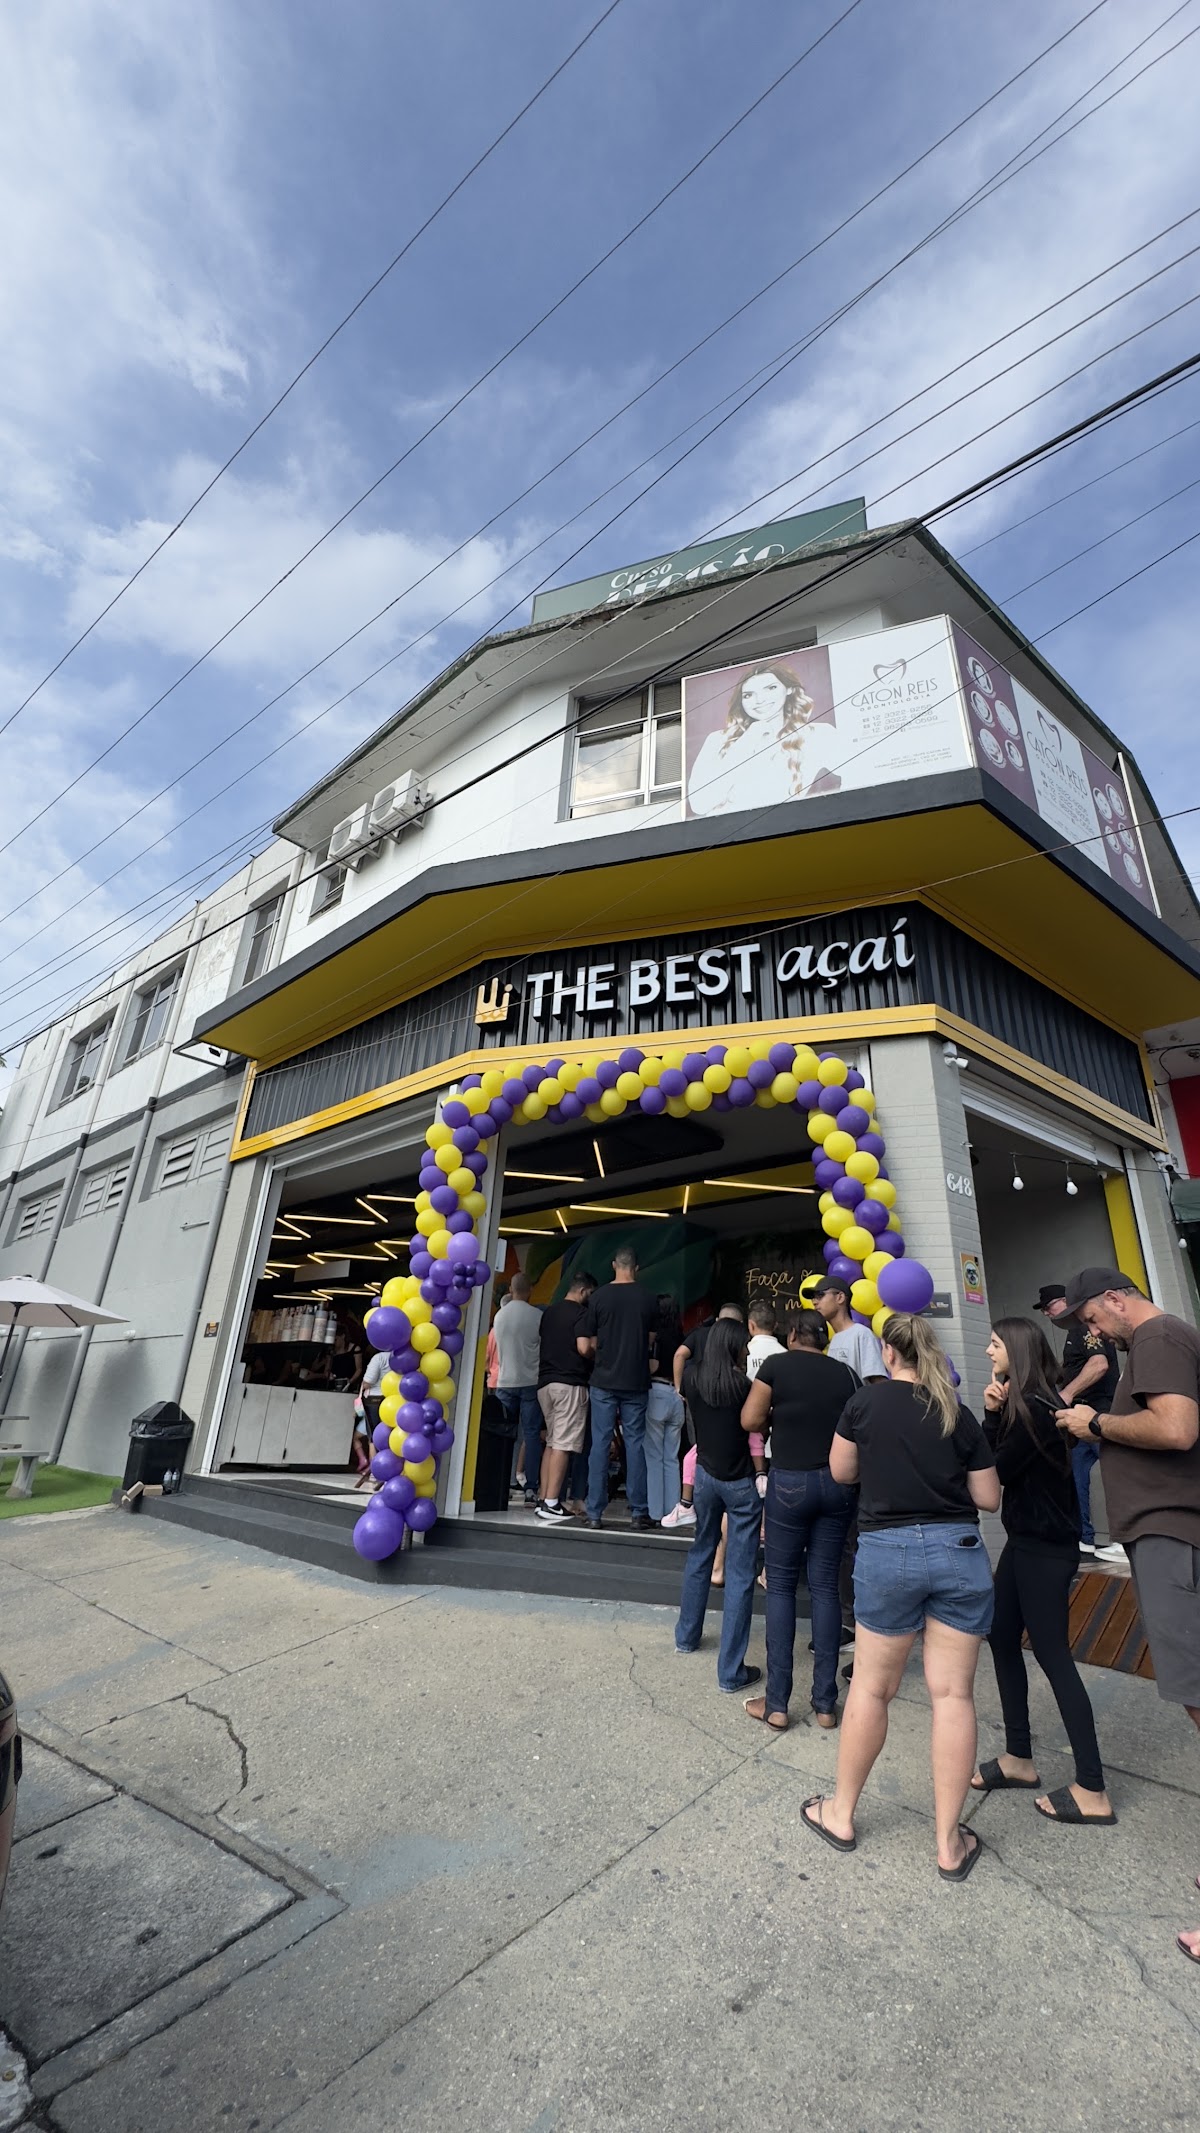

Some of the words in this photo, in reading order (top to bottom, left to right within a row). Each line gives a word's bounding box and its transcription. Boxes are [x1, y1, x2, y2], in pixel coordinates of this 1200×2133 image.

[610, 562, 673, 588] Curso
[851, 685, 902, 707] CATON
[907, 677, 938, 696] REIS
[860, 693, 931, 712] ODONTOLOGIA
[1026, 730, 1065, 776] CATON
[1065, 764, 1088, 797] REIS
[526, 962, 615, 1018] THE
[629, 943, 761, 1007] BEST
[776, 916, 916, 987] açaí
[946, 1172, 973, 1197] 648
[745, 1267, 794, 1297] Faça
